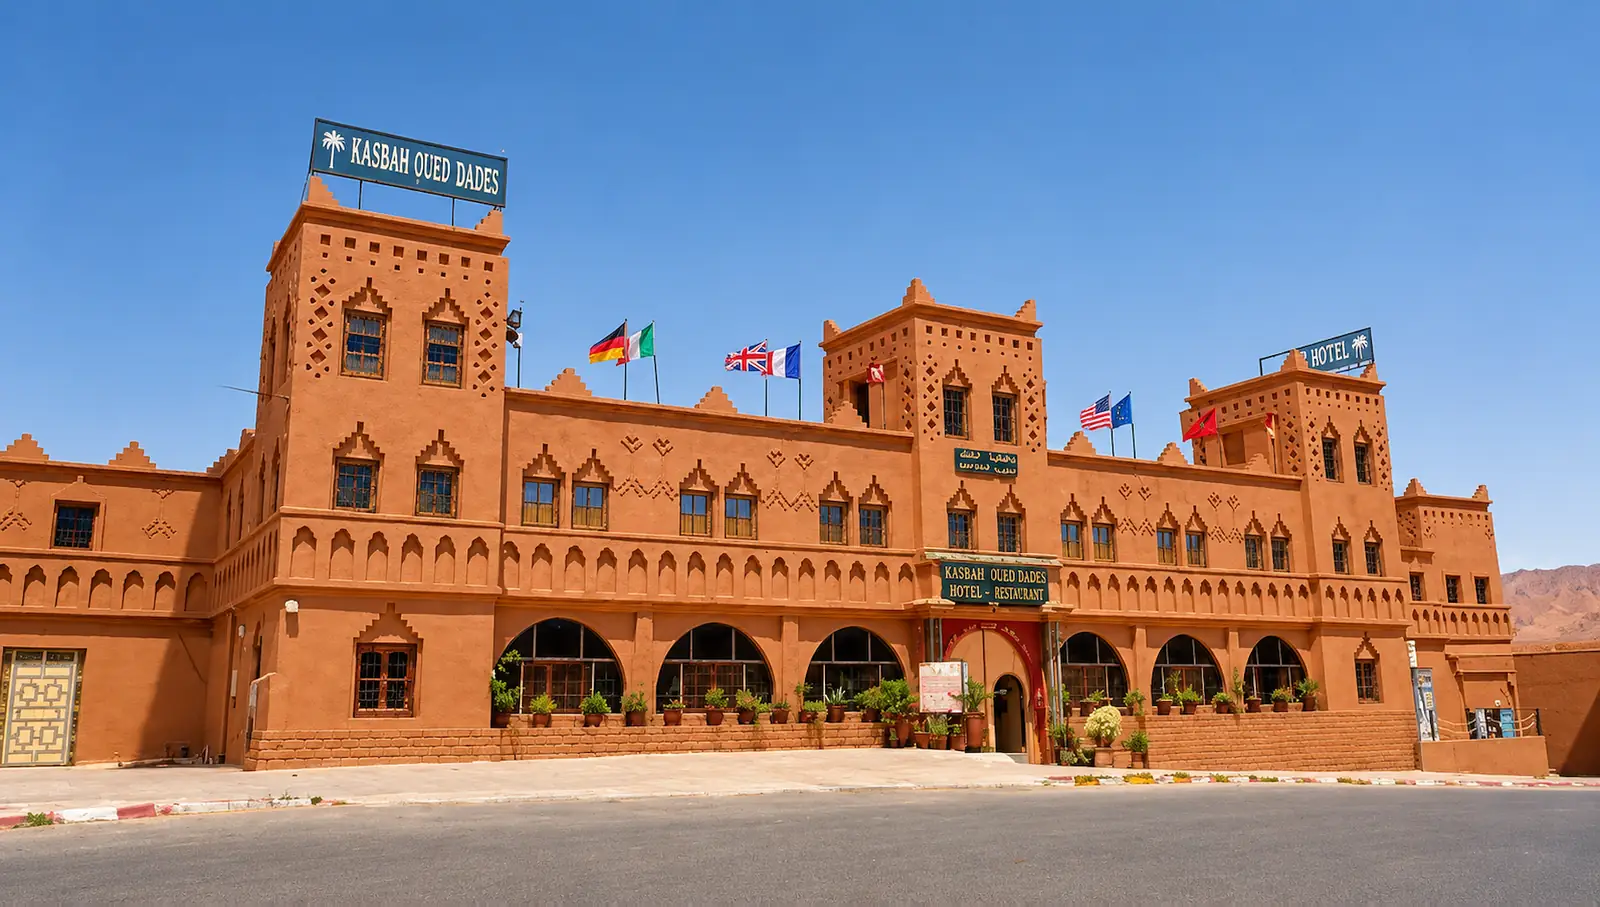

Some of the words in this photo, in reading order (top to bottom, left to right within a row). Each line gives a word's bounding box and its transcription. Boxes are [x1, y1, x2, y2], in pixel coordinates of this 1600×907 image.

[350, 137, 410, 174] KASBAH
[414, 152, 450, 182] OUED
[455, 161, 499, 195] DADES
[1311, 341, 1349, 367] HOTEL
[945, 566, 985, 580] KASBAH
[990, 568, 1015, 582] OUED
[1018, 570, 1047, 584] DADES
[950, 585, 982, 599] HOTEL
[995, 586, 1044, 600] RESTAURANT
